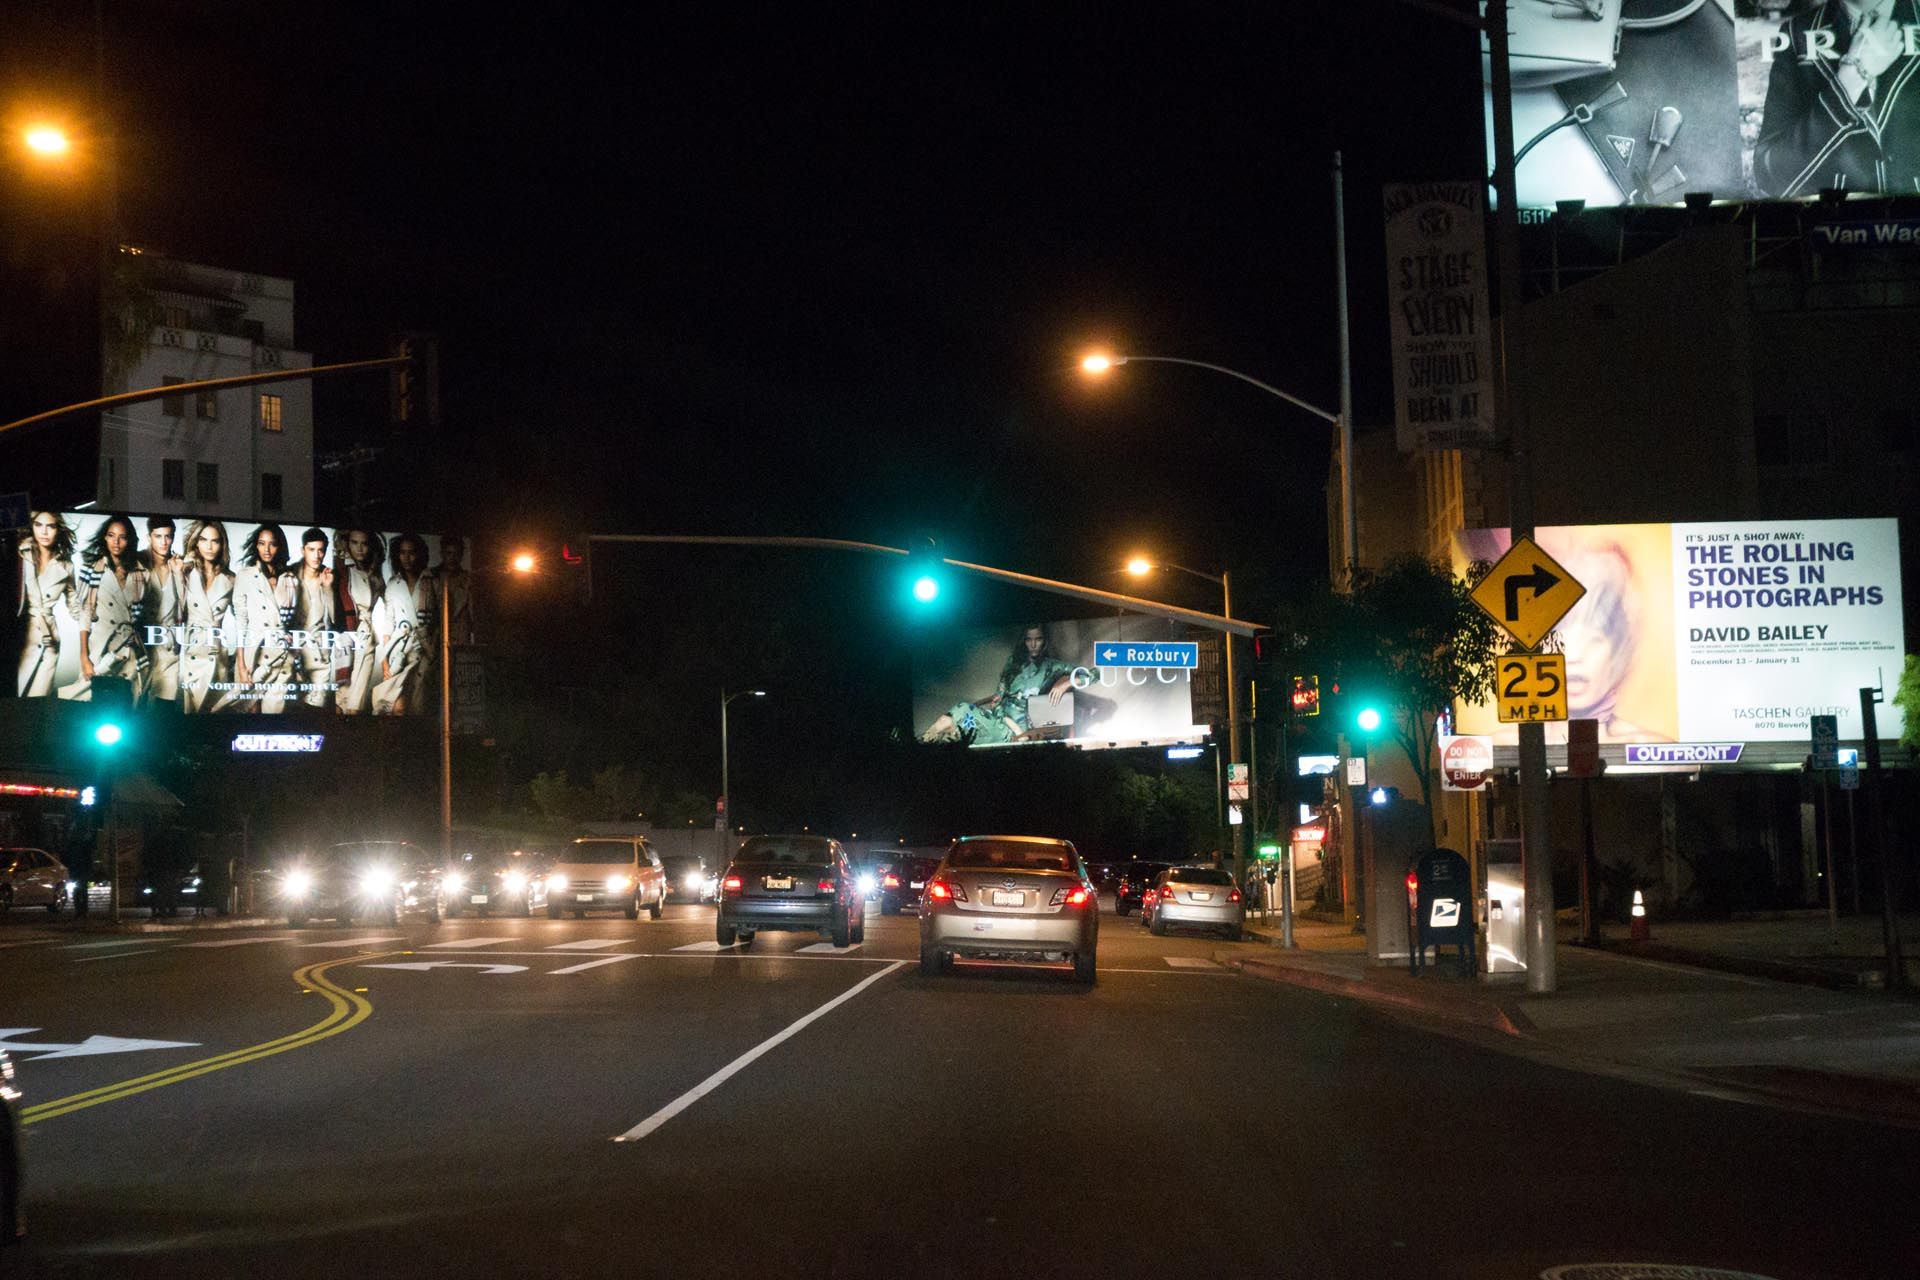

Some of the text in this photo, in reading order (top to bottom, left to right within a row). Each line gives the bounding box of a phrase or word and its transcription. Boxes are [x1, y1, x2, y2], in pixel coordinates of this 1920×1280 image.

[1824, 223, 1868, 244] Van
[1400, 250, 1473, 290] STAGE
[1402, 294, 1475, 336] EVERY
[1408, 352, 1479, 388] SHOULD
[1686, 534, 1703, 542] IT'S
[1707, 534, 1730, 542] JUST
[1744, 533, 1770, 541] SHOT
[1773, 532, 1804, 541] AWAY:
[1686, 542, 1854, 564] THE ROLLING
[1688, 565, 1824, 586] STONES IN
[1688, 586, 1884, 609] PHOTOGRAPHS
[144, 624, 370, 650] BURBERRY
[1689, 625, 1828, 642] DAVID BAILEY
[1127, 648, 1190, 665] Roxbury
[1690, 657, 1733, 665] December
[1755, 657, 1788, 665] January
[1790, 656, 1800, 664] 31
[1503, 661, 1560, 698] 25
[1510, 704, 1556, 719] MPH
[1733, 706, 1850, 719] TASCHEN GALLERY
[1778, 721, 1809, 730] Beverly
[1450, 746, 1463, 757] DO
[1636, 745, 1731, 762] OUTFRONT
[1454, 770, 1481, 780] ENTER
